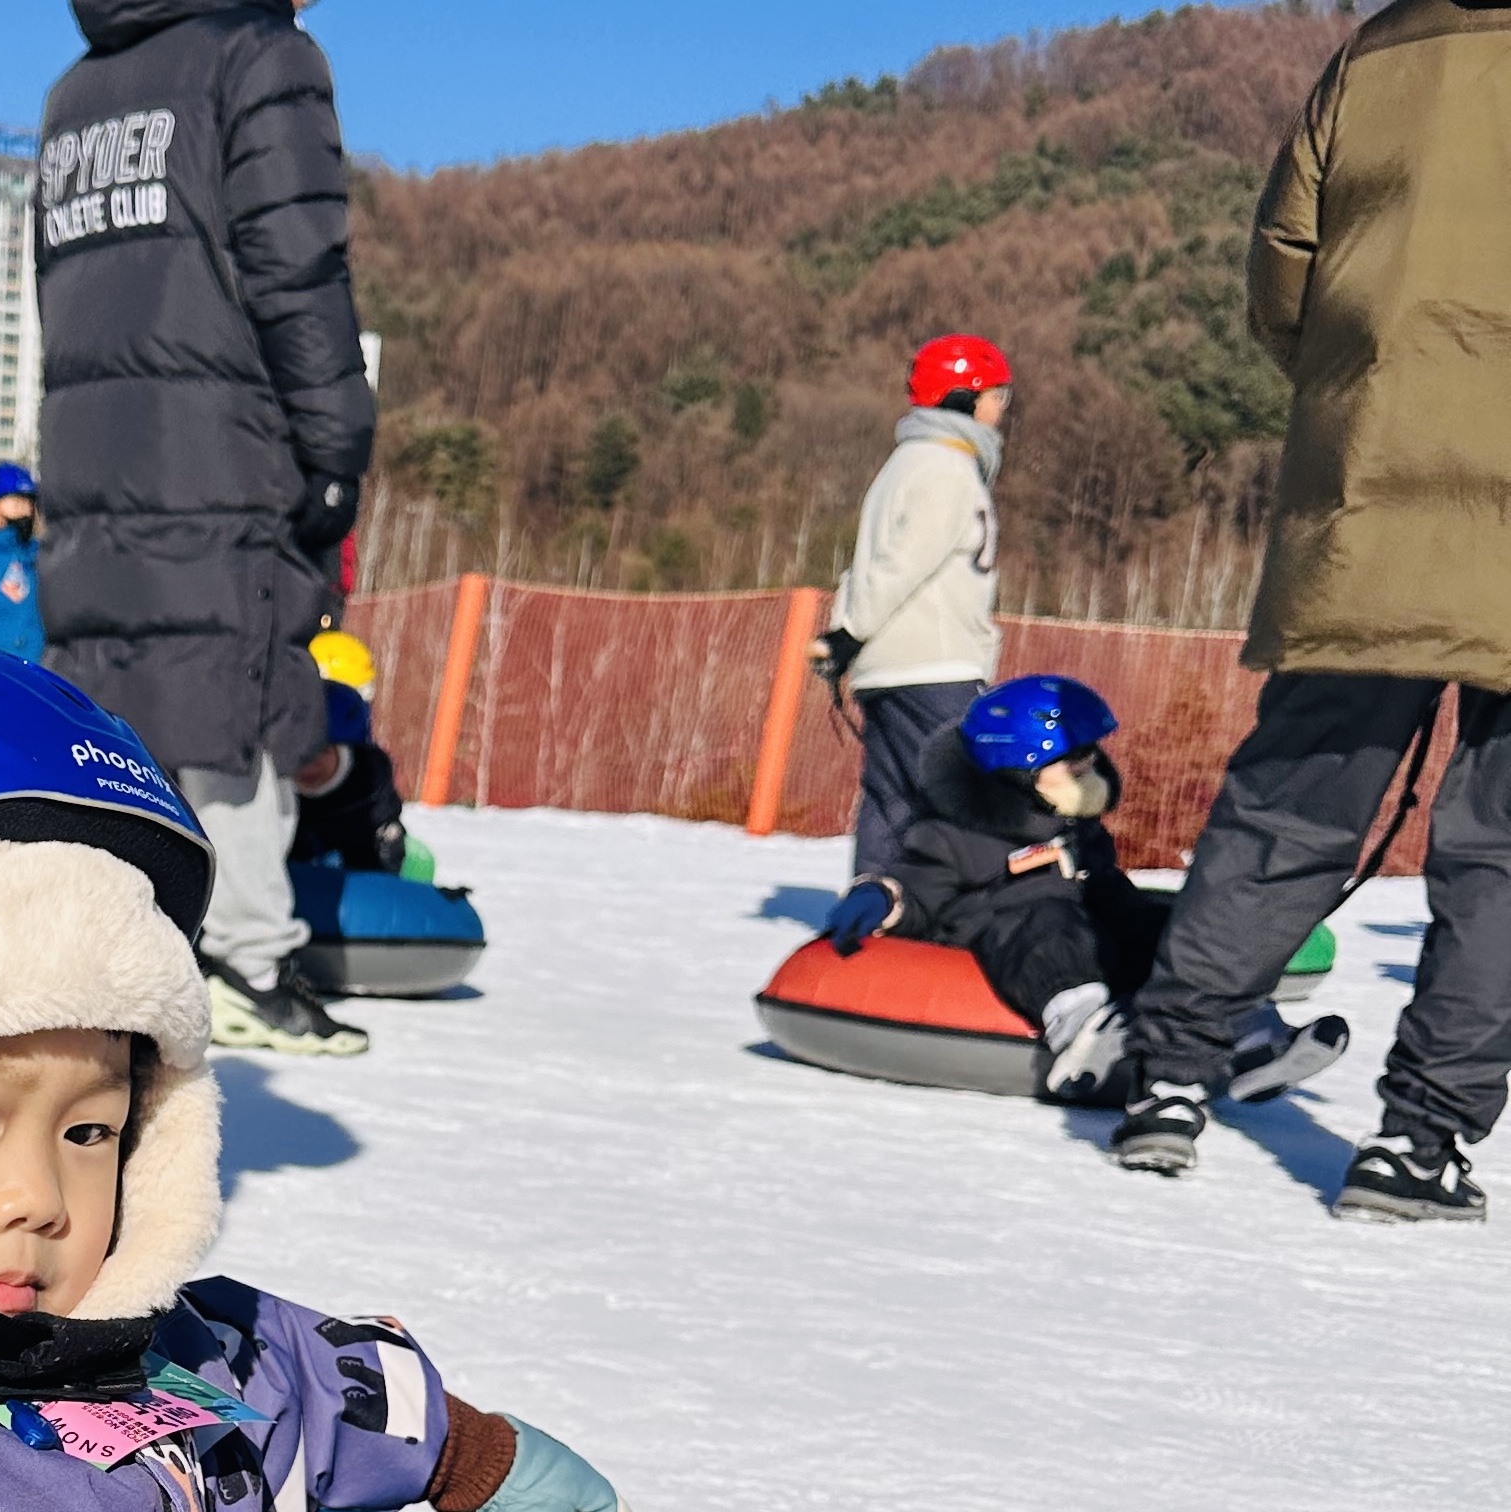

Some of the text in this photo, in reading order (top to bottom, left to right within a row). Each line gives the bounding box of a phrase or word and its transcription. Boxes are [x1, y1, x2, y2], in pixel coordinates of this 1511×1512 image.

[40, 108, 176, 209] SPYDER
[111, 182, 167, 229] CLUB
[71, 739, 176, 798] phoenix
